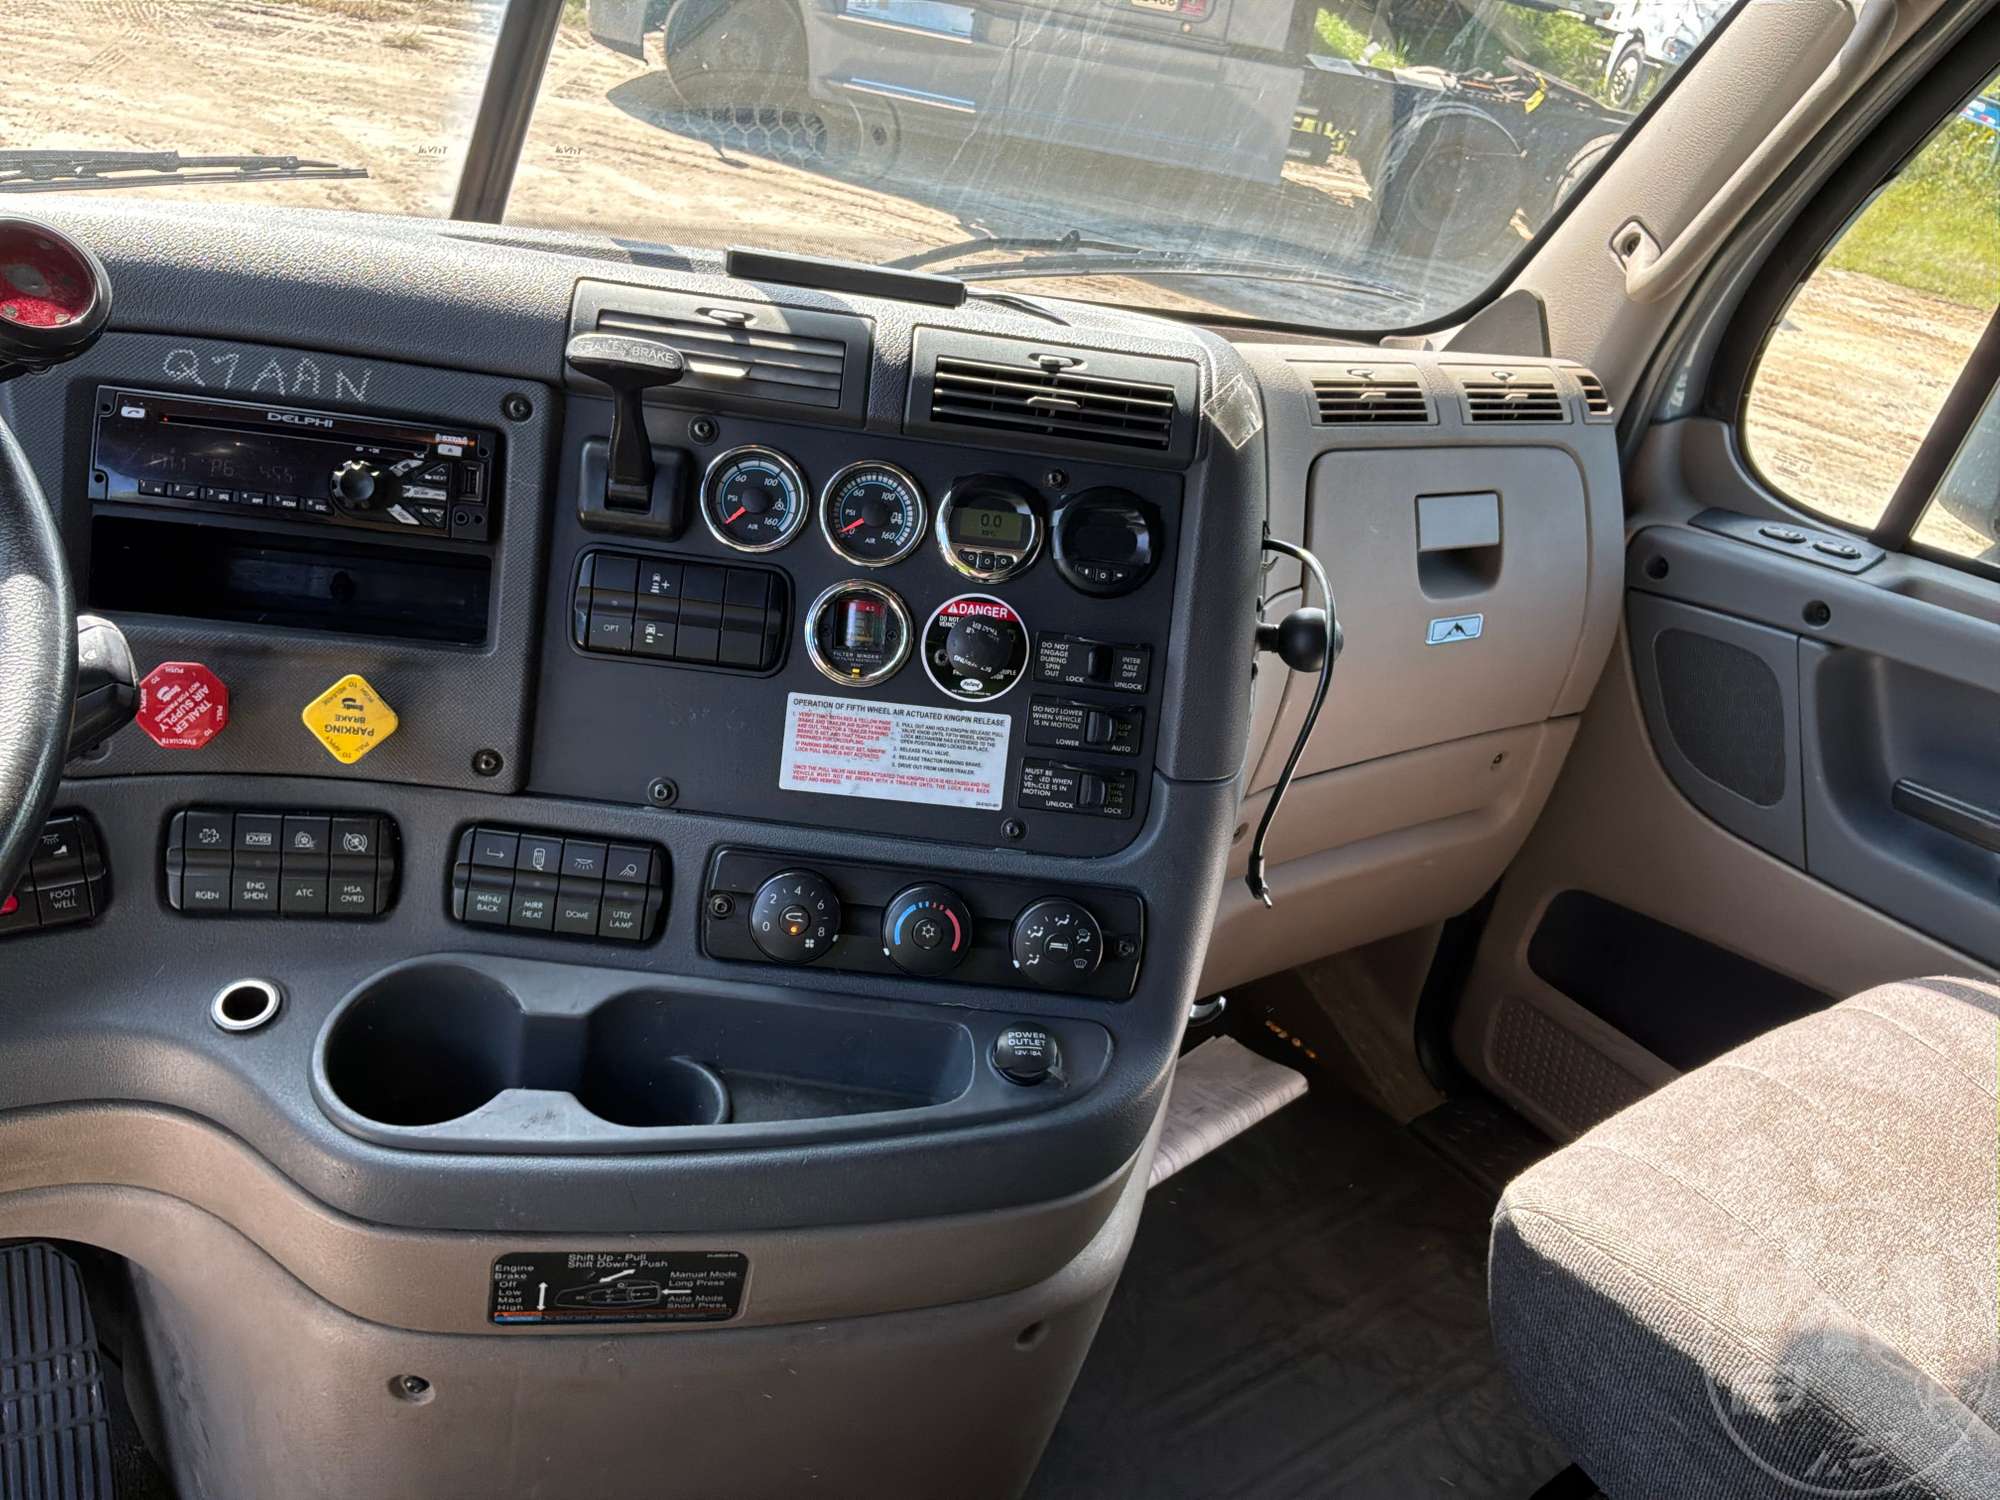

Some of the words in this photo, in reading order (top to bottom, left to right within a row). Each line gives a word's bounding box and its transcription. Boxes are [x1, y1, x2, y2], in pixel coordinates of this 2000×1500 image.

[632, 347, 674, 362] BRAKE
[267, 412, 334, 428] DELPHI
[764, 478, 777, 487] 100
[853, 489, 864, 497] 60
[881, 492, 895, 500] 100
[764, 518, 778, 526] 160
[981, 513, 1002, 527] 0.0
[881, 532, 895, 540] 160
[959, 604, 1008, 618] DANGER
[603, 624, 619, 632] OPT
[1040, 649, 1069, 657] ENGAGE
[1040, 656, 1067, 664] DURING
[1066, 675, 1084, 683] LOCK
[1114, 682, 1142, 691] UNLOCK
[192, 684, 209, 702] AIR
[160, 699, 194, 732] SUPPLY
[793, 698, 833, 709] OPERATION
[846, 704, 865, 712] FIFTH
[866, 706, 891, 715] WHEEL
[905, 710, 942, 720] ACTUATED
[943, 714, 971, 723] KINGPIN
[972, 717, 1005, 726] RELEASE
[1045, 706, 1058, 714] NOT
[1060, 708, 1083, 716] LOWER
[175, 700, 212, 734] TRAILER
[336, 714, 366, 723] BRAKE
[1055, 715, 1081, 723] VEHICLE
[324, 724, 374, 736] PARKING
[1051, 721, 1079, 730] MOTION
[1056, 738, 1079, 747] LOWER
[1111, 745, 1131, 753] AUTO
[1025, 768, 1044, 776] MUST
[1052, 777, 1073, 785] WHEN
[1023, 788, 1051, 797] MOTION
[1046, 800, 1074, 809] UNLOCK
[1104, 807, 1122, 815] LOCK
[246, 882, 265, 890] ENG
[344, 886, 362, 894] HSA
[50, 888, 76, 900] FOOT
[195, 891, 219, 900] RGEN
[243, 891, 268, 900] SHDN
[296, 888, 313, 897] ATC
[794, 886, 801, 896] 4
[340, 894, 365, 903] OVRD
[477, 894, 502, 904] MENU
[769, 894, 777, 904] 2
[53, 899, 76, 909] WELL
[477, 903, 499, 913] BACK
[524, 901, 543, 910] MIRR
[817, 900, 824, 910] 6
[523, 910, 543, 919] HEAT
[566, 910, 589, 920] DOME
[613, 911, 631, 919] UTLY
[609, 919, 633, 929] LAMP
[762, 922, 770, 931] 0
[818, 927, 824, 936] 8
[598, 1254, 613, 1262] Up
[495, 1264, 534, 1273] Engine
